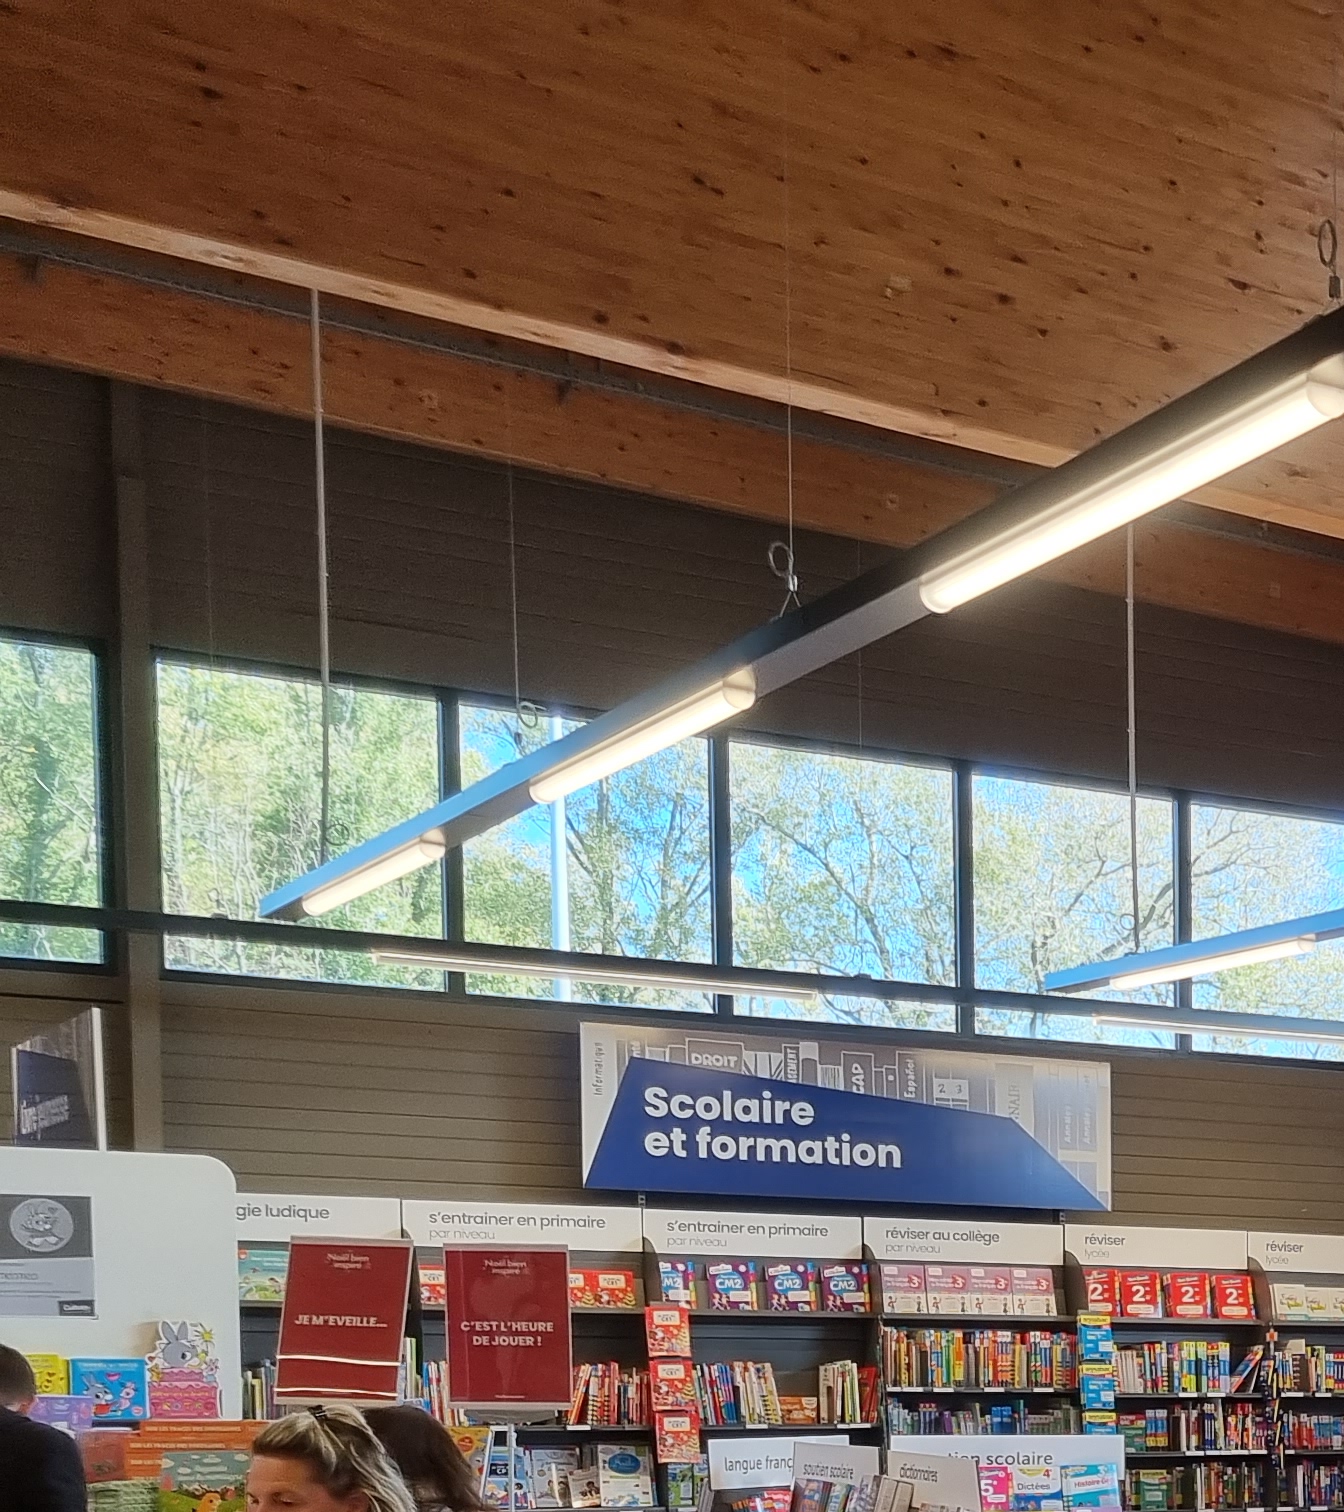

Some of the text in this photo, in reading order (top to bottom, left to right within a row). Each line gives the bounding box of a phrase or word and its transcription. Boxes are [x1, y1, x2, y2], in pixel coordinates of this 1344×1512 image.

[691, 1053, 737, 1069] DROIT
[643, 1086, 815, 1127] Scolaire
[644, 1127, 901, 1169] et formation
[265, 1204, 329, 1222] ludique
[428, 1212, 606, 1231] s'entrainer en primaire
[429, 1230, 450, 1241] par
[667, 1220, 828, 1238] s'entrainer en primaire
[667, 1237, 687, 1248] par
[885, 1228, 1000, 1247] réviser au collège
[1084, 1234, 1126, 1247] réviser
[1265, 1241, 1304, 1254] réviser
[715, 1278, 744, 1290] CM2
[295, 1314, 312, 1326] JE
[460, 1321, 554, 1333] C'EST L'HEURE
[472, 1336, 533, 1347] DE JOUER
[986, 1451, 1054, 1465] scolaire
[724, 1456, 763, 1475] langue
[803, 1462, 854, 1480] soutien scolaire
[1017, 1481, 1051, 1491] Dictées
